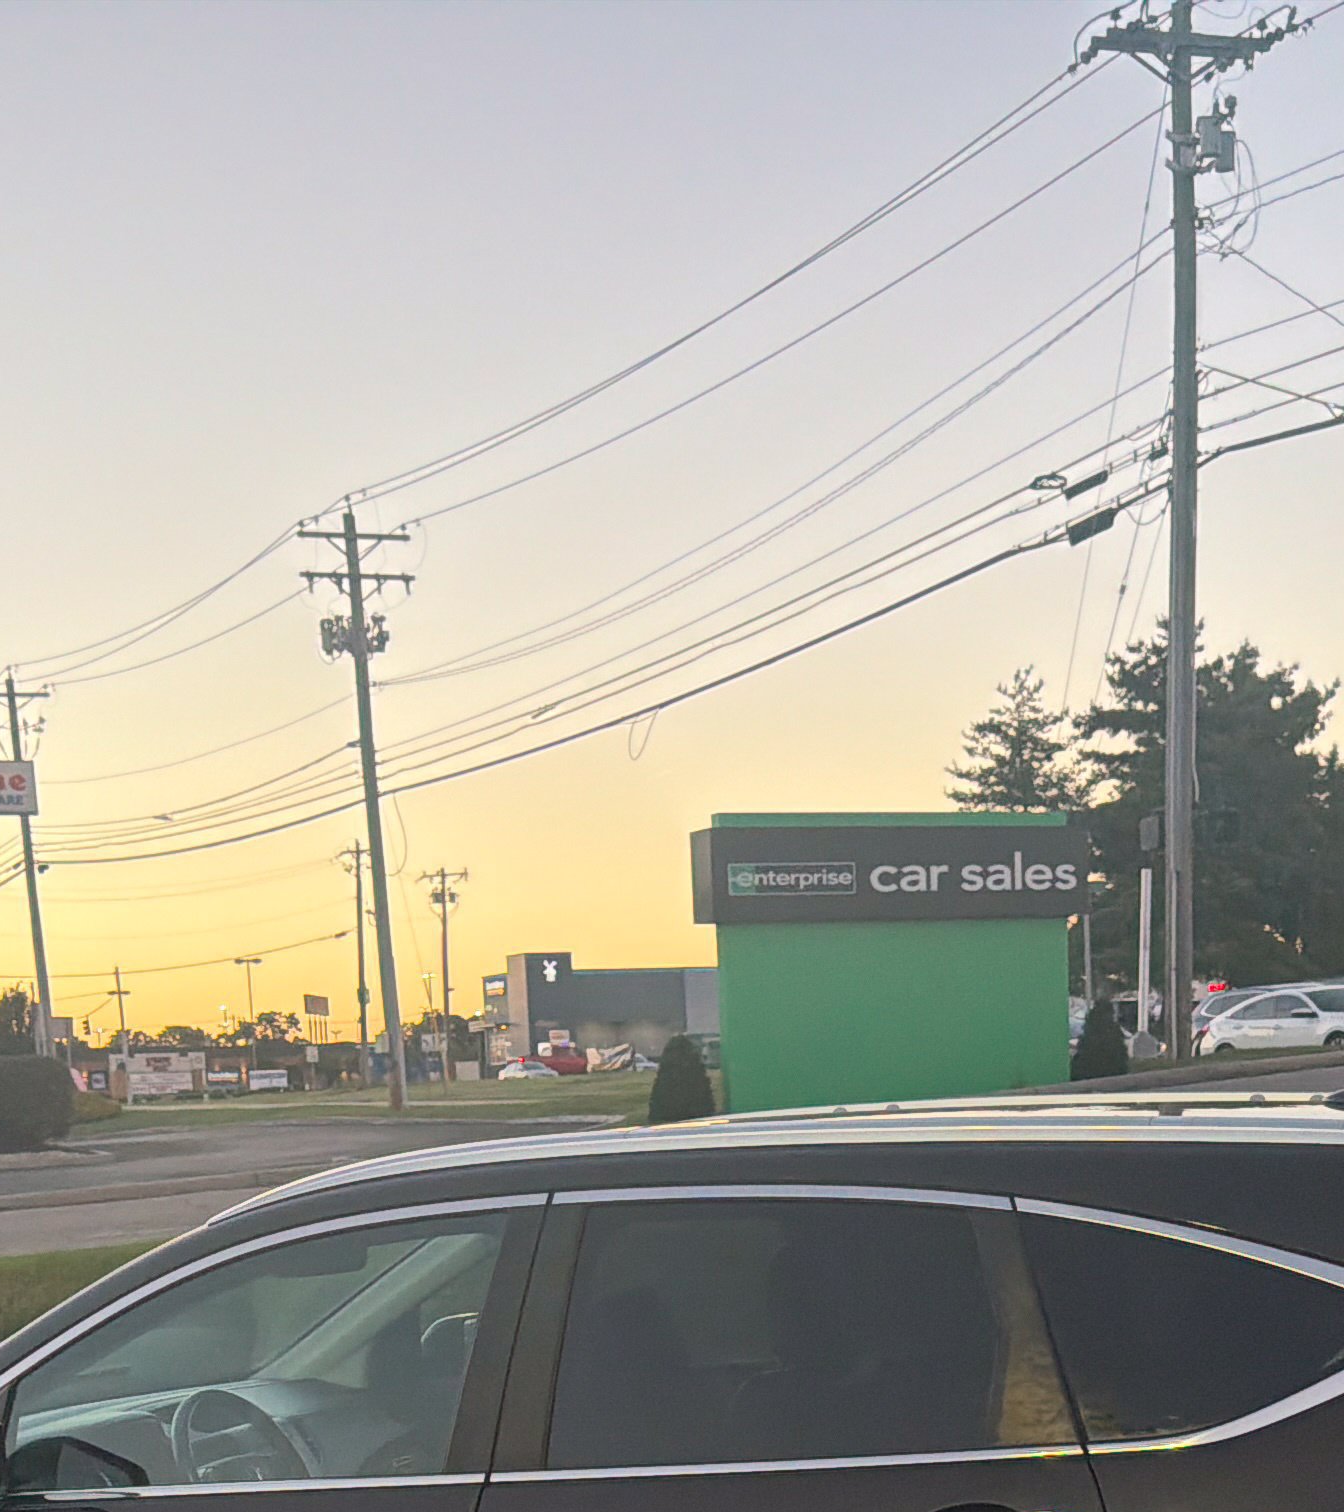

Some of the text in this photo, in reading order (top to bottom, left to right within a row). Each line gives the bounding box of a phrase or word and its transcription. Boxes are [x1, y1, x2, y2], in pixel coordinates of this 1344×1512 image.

[733, 850, 1078, 893] enterprise car sales
